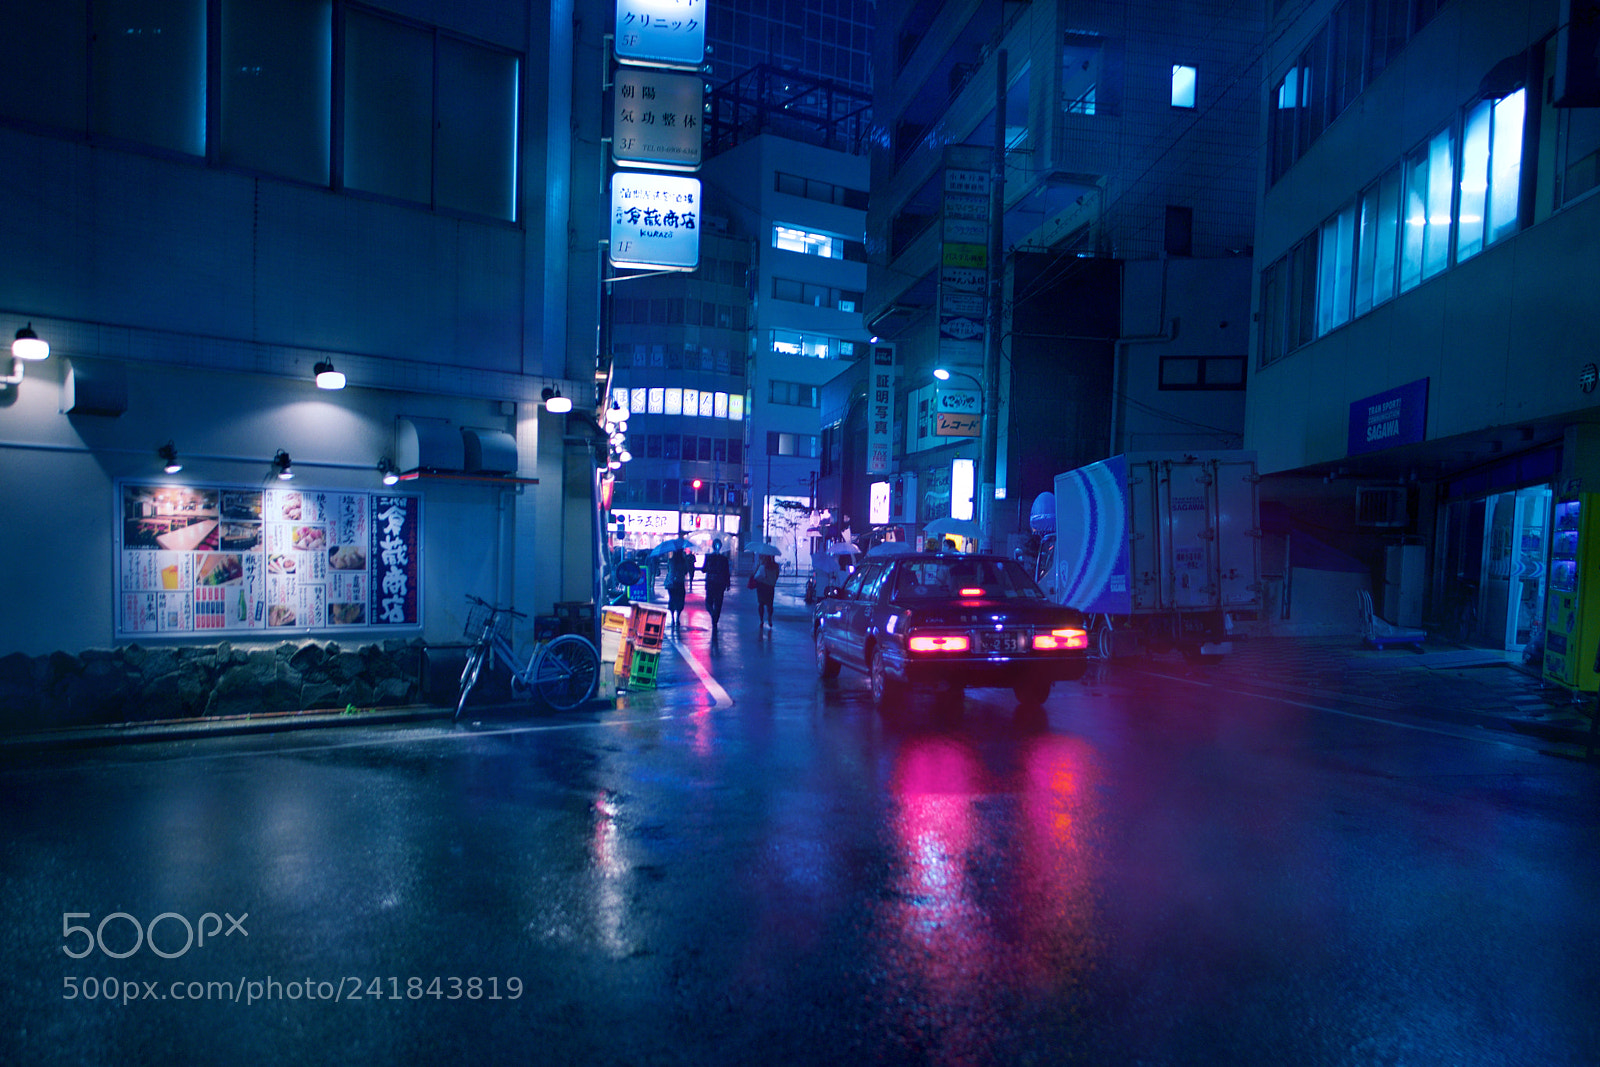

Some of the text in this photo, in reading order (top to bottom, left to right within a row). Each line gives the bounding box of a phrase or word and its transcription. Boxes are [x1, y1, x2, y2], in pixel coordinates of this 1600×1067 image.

[624, 11, 698, 32] クリニック
[622, 34, 638, 47] 5F
[620, 108, 697, 129] 気功整体
[620, 138, 635, 150] 3F
[624, 206, 695, 229] 倉蔵商店
[618, 241, 632, 252] 1F
[874, 374, 888, 434] 証明写真
[941, 420, 979, 431] レコード
[1367, 419, 1399, 442] SAGAWA
[380, 498, 407, 507] 二代目
[1172, 503, 1205, 511] SAGAWA
[378, 505, 409, 623] 倉蔵商店
